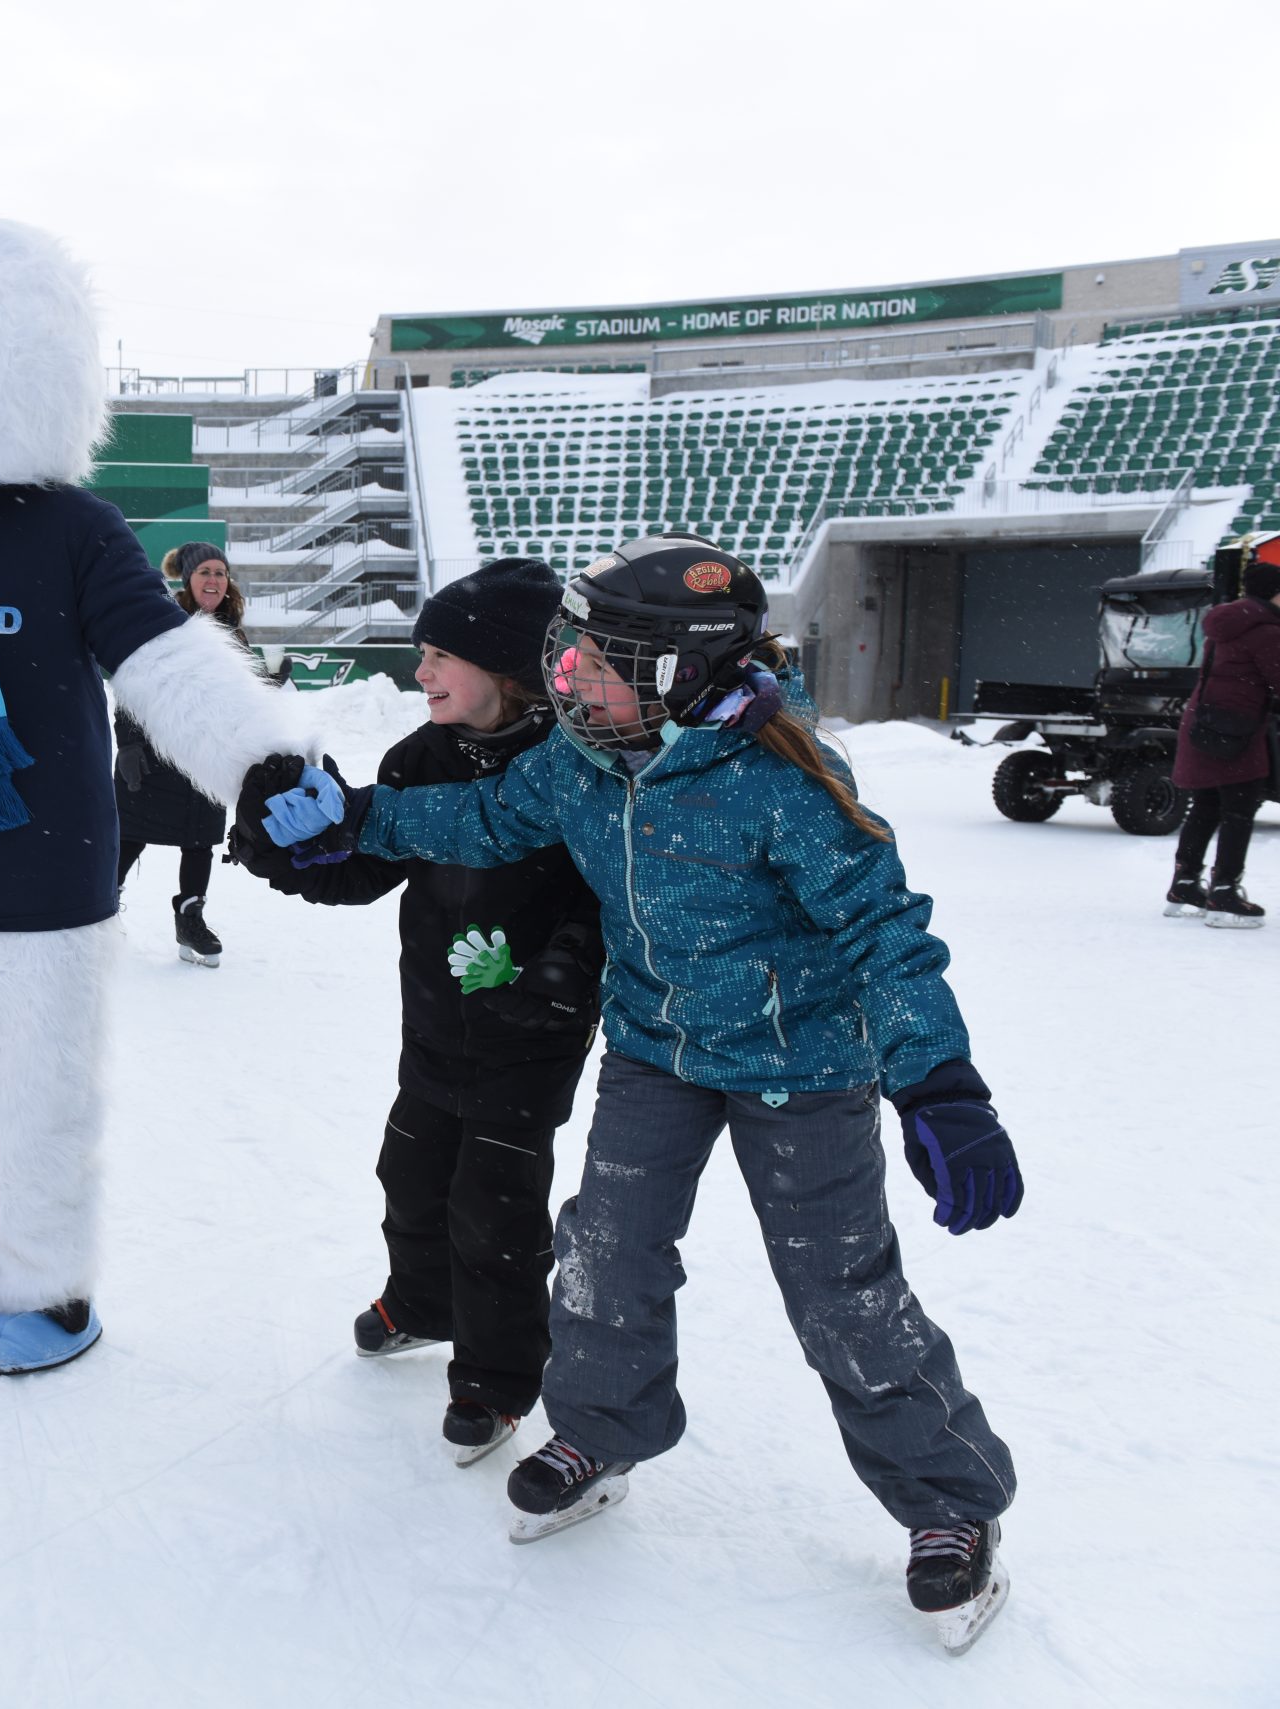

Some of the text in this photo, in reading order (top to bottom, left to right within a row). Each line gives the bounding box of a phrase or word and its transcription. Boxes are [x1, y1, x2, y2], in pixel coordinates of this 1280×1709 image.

[503, 315, 566, 332] Mosaic
[575, 317, 660, 336] STADIUM
[682, 311, 741, 331] HOME
[745, 309, 772, 327] OF
[776, 304, 836, 324] RIDER
[842, 297, 916, 320] NATION
[688, 566, 722, 579] REGINA
[691, 573, 725, 589] Rebels
[688, 623, 735, 632] BAUER
